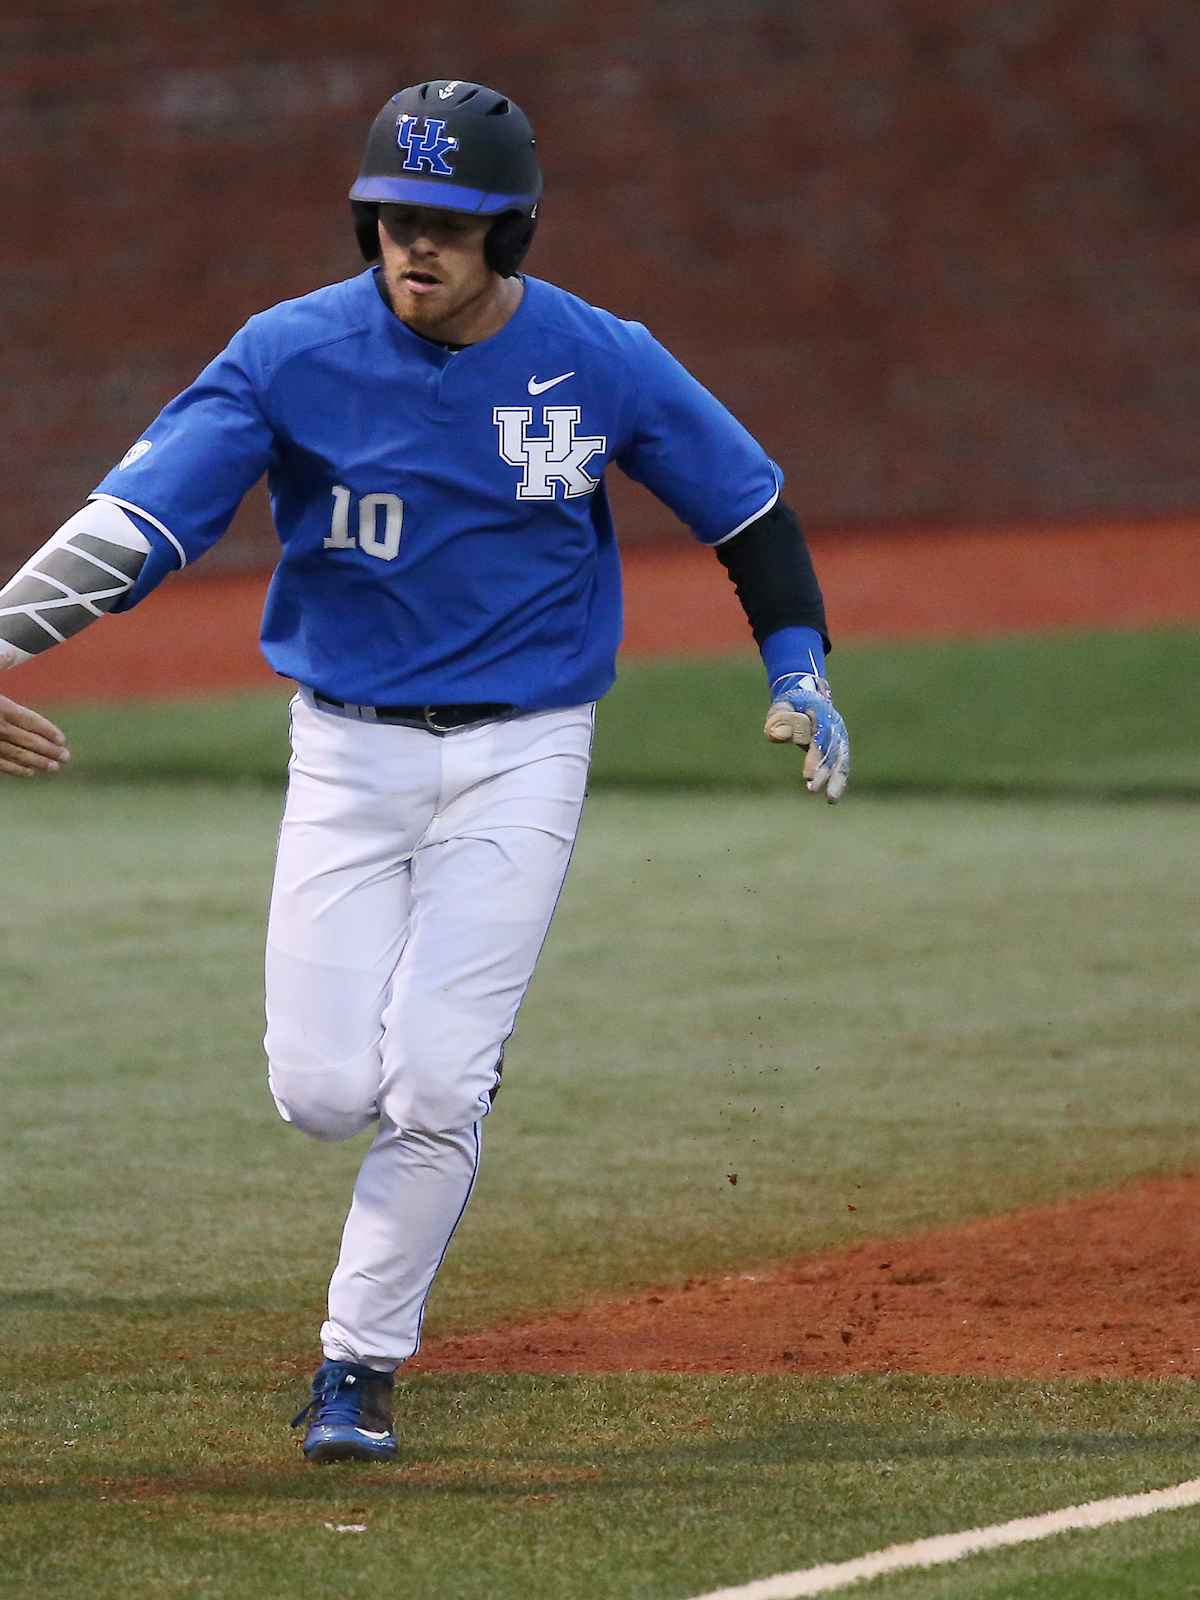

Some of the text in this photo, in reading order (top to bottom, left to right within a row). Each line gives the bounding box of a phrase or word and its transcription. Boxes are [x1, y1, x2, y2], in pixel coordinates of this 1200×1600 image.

[397, 115, 459, 176] UK
[493, 406, 606, 501] UK
[323, 485, 403, 561] 10
